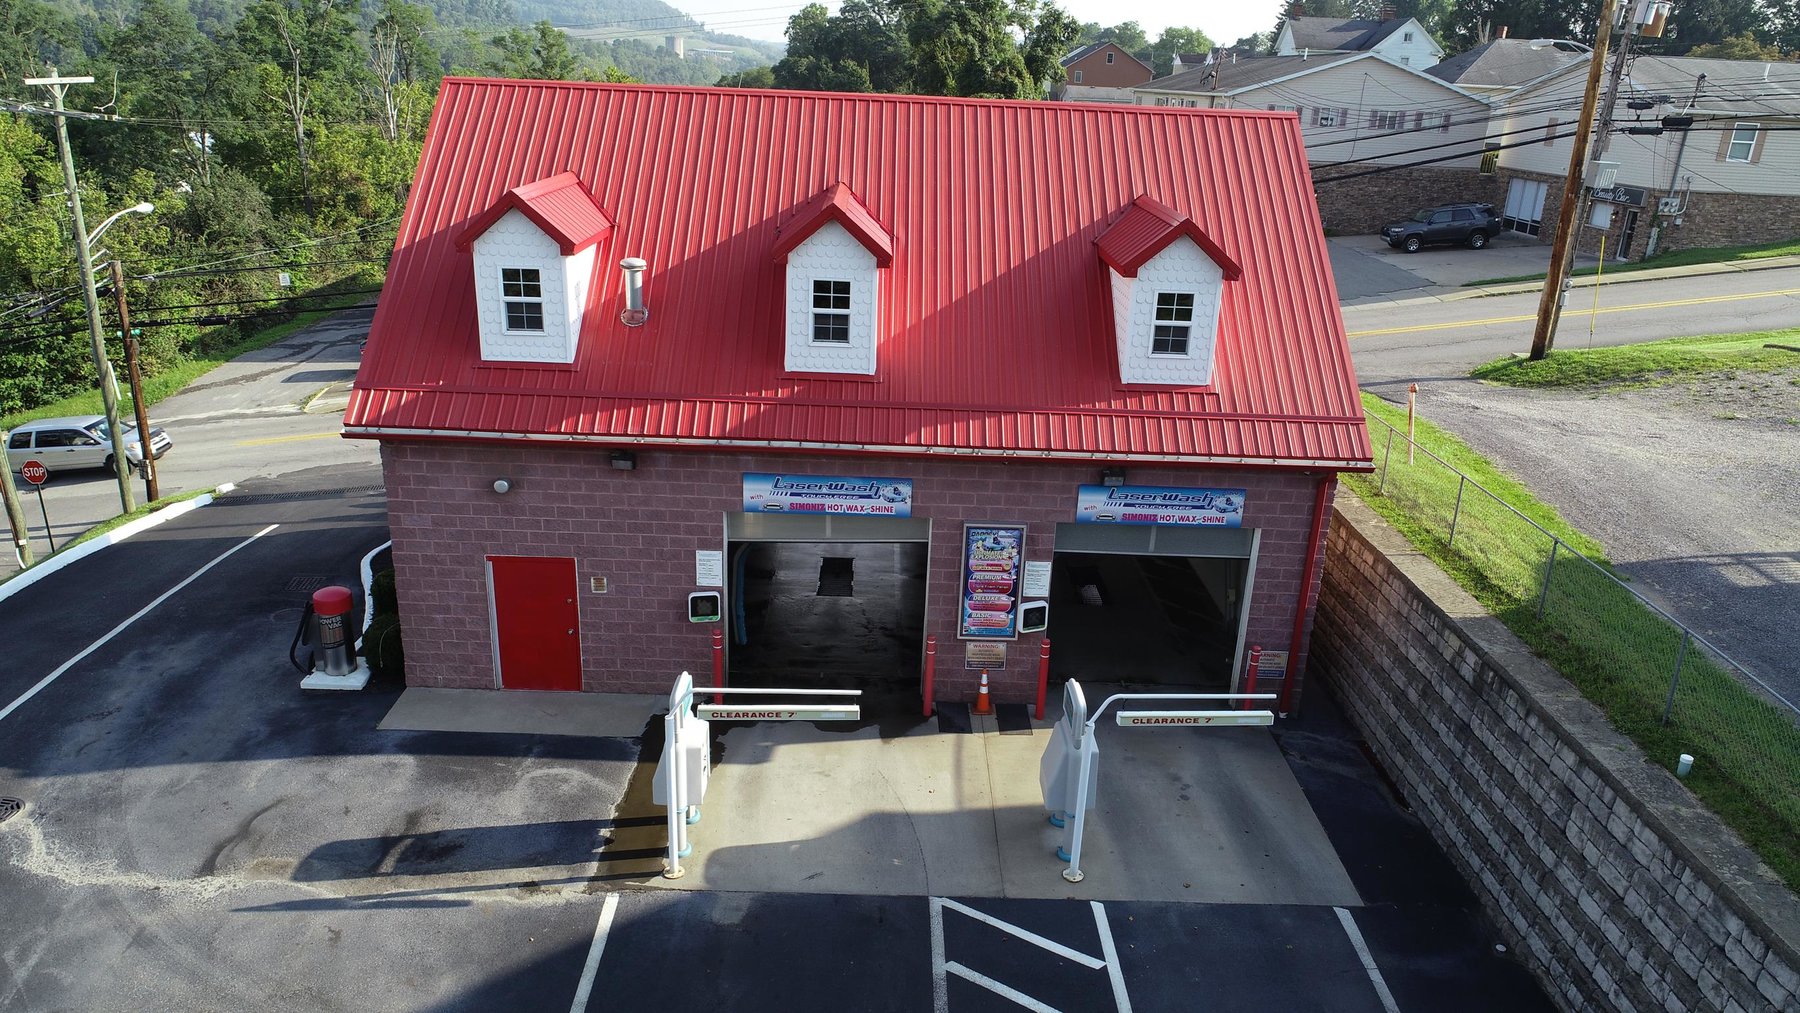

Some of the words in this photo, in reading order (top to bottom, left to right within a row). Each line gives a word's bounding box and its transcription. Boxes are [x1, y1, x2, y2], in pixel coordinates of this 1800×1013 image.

[24, 467, 44, 477] STOP
[789, 502, 826, 511] SIMONIZ
[1121, 513, 1158, 521] SIMONIZ
[711, 711, 782, 719] CLEARANCE
[1132, 717, 1199, 725] CLEARANCE
